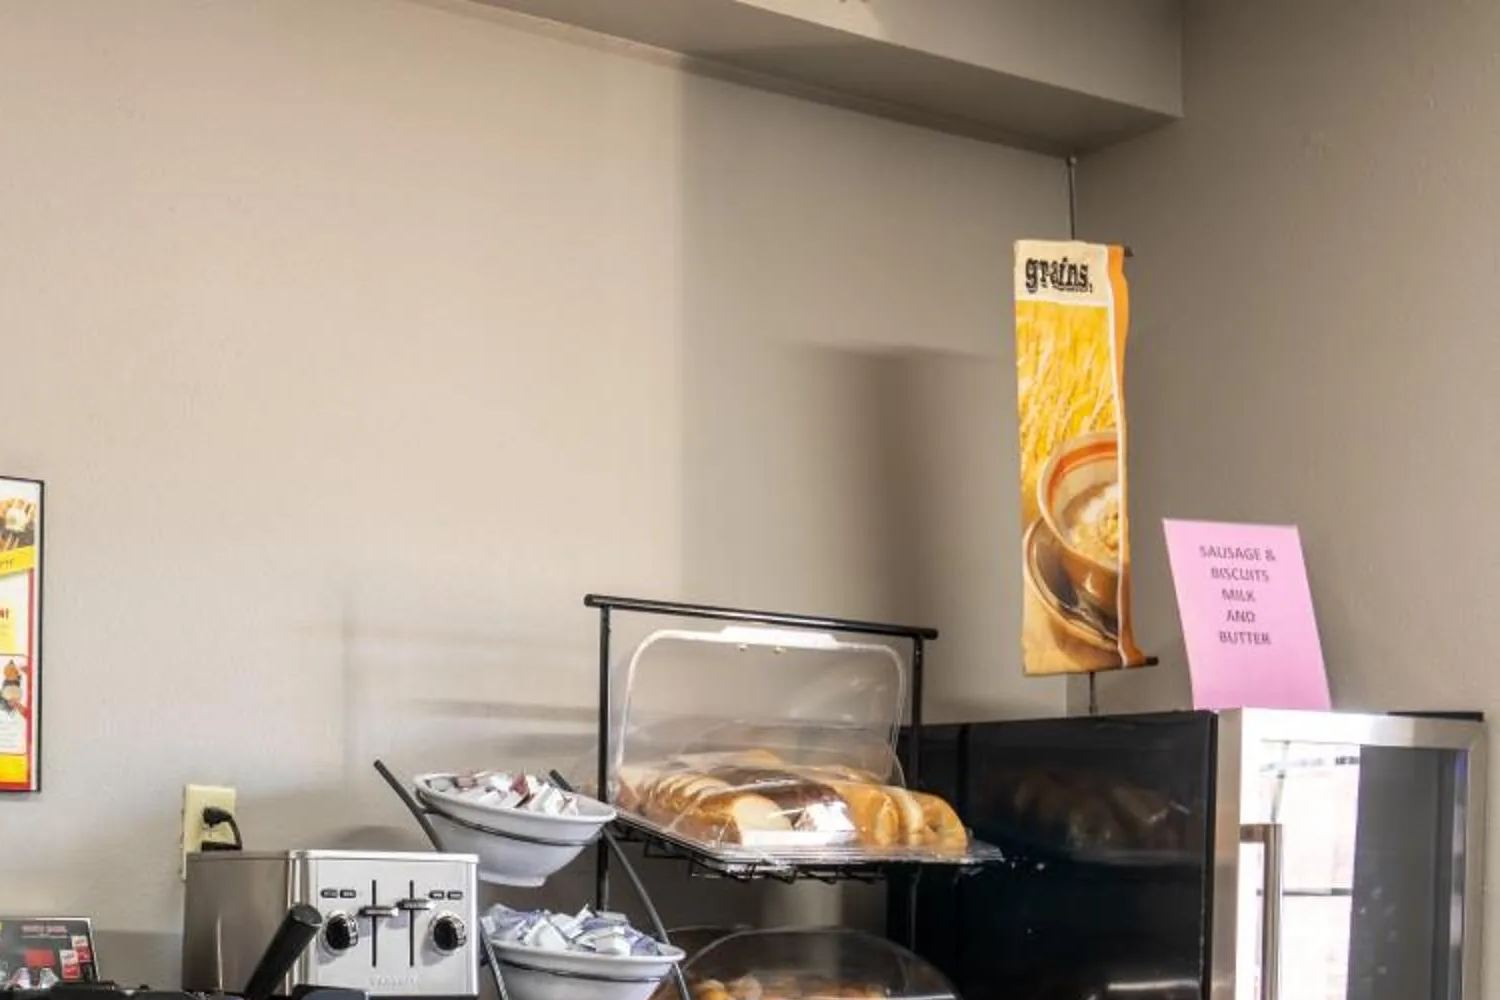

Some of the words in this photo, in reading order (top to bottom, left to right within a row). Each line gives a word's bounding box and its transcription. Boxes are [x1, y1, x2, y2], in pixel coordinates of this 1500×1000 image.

[1025, 257, 1089, 293] grains
[1199, 545, 1261, 561] SAUSAGE
[1265, 550, 1276, 562] &
[1211, 567, 1270, 582] BISCUITS
[1221, 588, 1256, 602] MILK
[1225, 610, 1256, 623] AND
[1218, 631, 1273, 645] BUTTER
